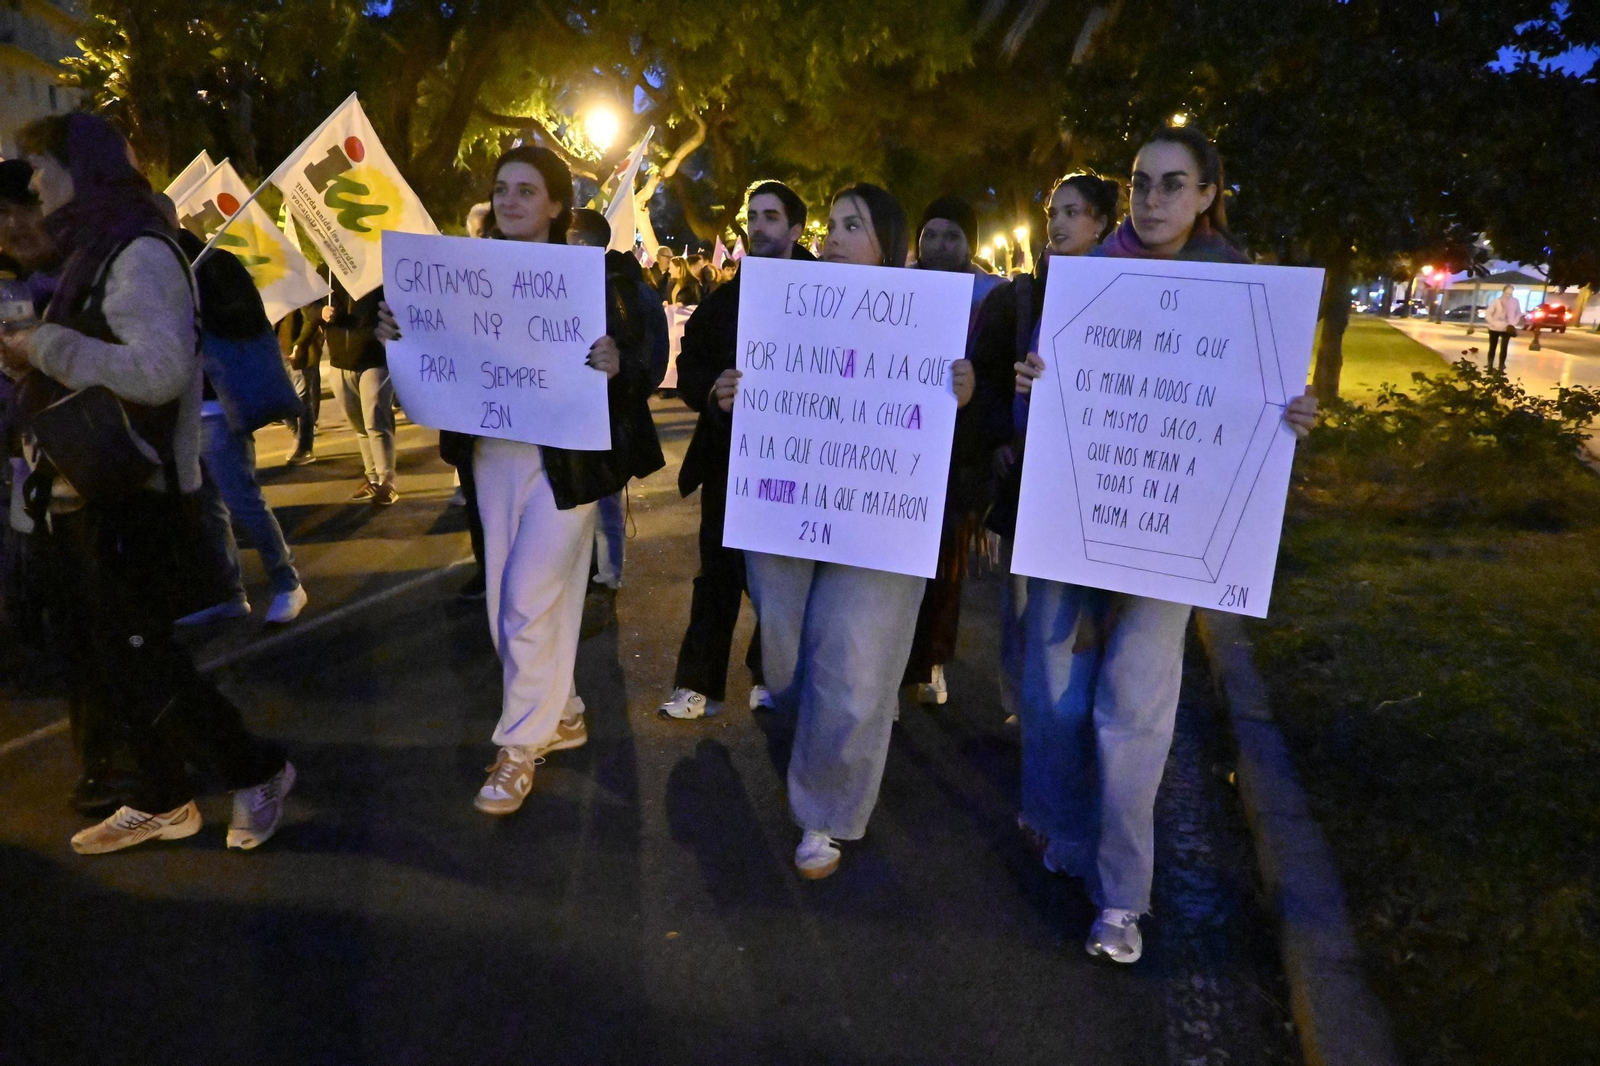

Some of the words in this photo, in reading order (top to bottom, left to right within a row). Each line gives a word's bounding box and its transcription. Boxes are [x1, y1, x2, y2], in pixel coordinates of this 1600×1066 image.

[316, 209, 332, 231] unida
[339, 243, 358, 270] verdes
[395, 258, 493, 299] GRITAMOS
[512, 270, 567, 300] AHORA
[784, 282, 846, 319] ESTOY
[1160, 289, 1180, 311] OS
[407, 305, 446, 332] PARA
[528, 316, 585, 343] CALLAR
[1085, 325, 1142, 351] PREOCUPA
[1153, 328, 1181, 355] MÁS
[1195, 336, 1230, 359] QUE
[420, 354, 457, 382] PARA
[481, 361, 548, 389] SIEMPRE
[745, 340, 777, 371] POR
[785, 344, 803, 373] LA
[809, 346, 856, 379] NIÑA
[864, 352, 875, 379] A
[887, 354, 908, 381] LA
[918, 356, 951, 387] QUE
[1076, 368, 1093, 392] OS
[1100, 372, 1134, 397] METAN
[1138, 377, 1148, 398] A
[1153, 378, 1191, 405] TODOS
[1196, 385, 1216, 408] EN
[480, 401, 512, 429] 25N
[743, 388, 769, 413] NO
[774, 391, 844, 424] CREYERON,
[852, 399, 866, 424] LA
[877, 401, 922, 430] CHICA
[1082, 407, 1093, 426] EL
[1103, 408, 1148, 434] MISMO
[1213, 424, 1223, 446] A
[739, 434, 749, 457] A
[759, 435, 774, 460] LA
[784, 435, 812, 465] QUE
[910, 453, 921, 476] Y
[1087, 441, 1112, 462] QUE
[1114, 445, 1138, 467] NOS
[1143, 447, 1180, 473] METAN
[1186, 456, 1196, 477] A
[735, 477, 749, 498] LA
[758, 478, 796, 504] MUJER
[801, 482, 809, 505] A
[814, 484, 827, 510] LA
[833, 486, 858, 512] QUE
[861, 490, 929, 522] MATARON
[1096, 473, 1134, 494] TODAS
[1143, 478, 1160, 499] EN
[1164, 483, 1179, 504] LA
[1091, 503, 1128, 529] MISMA
[1138, 511, 1170, 533] CAJA
[1218, 584, 1249, 609] 25N
